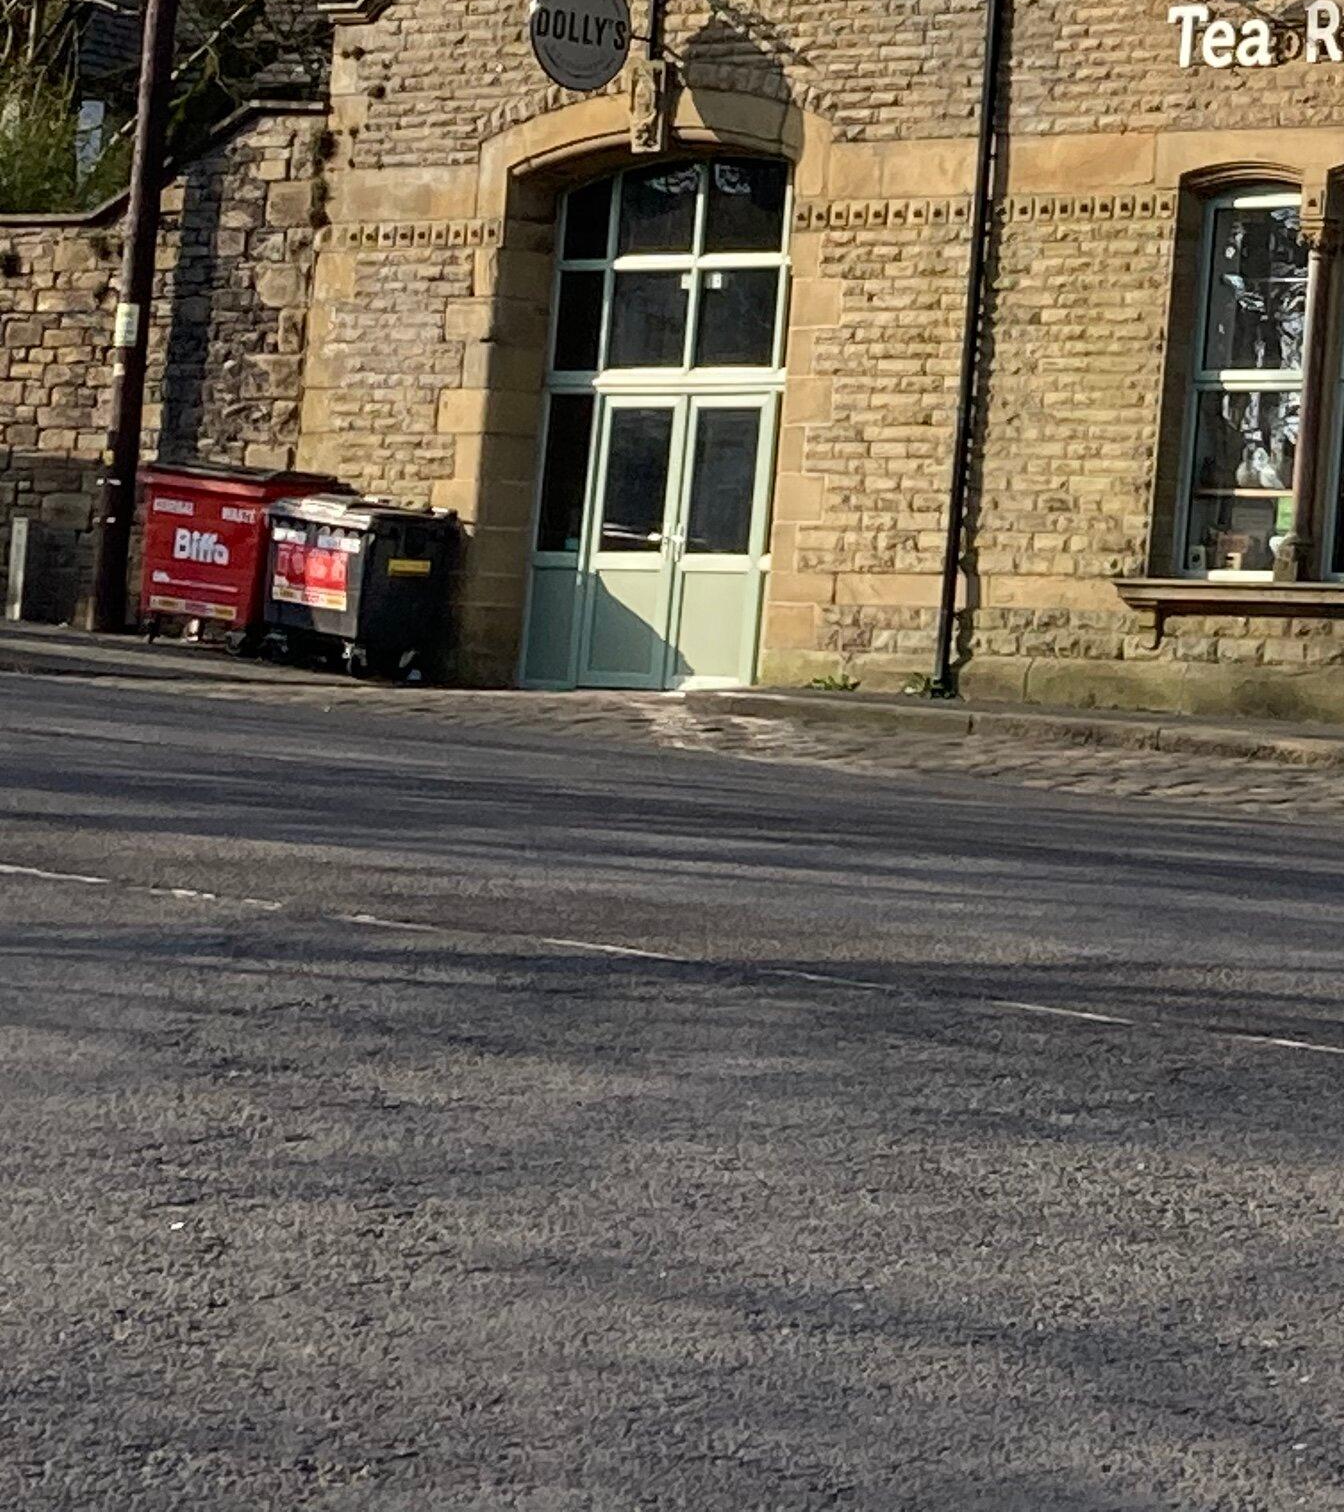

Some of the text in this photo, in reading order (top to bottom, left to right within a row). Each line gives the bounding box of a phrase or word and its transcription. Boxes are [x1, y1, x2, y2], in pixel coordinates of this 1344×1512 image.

[536, 7, 627, 50] DOLLY'S
[1167, 4, 1275, 68] Tea
[173, 527, 230, 566] Biffa
